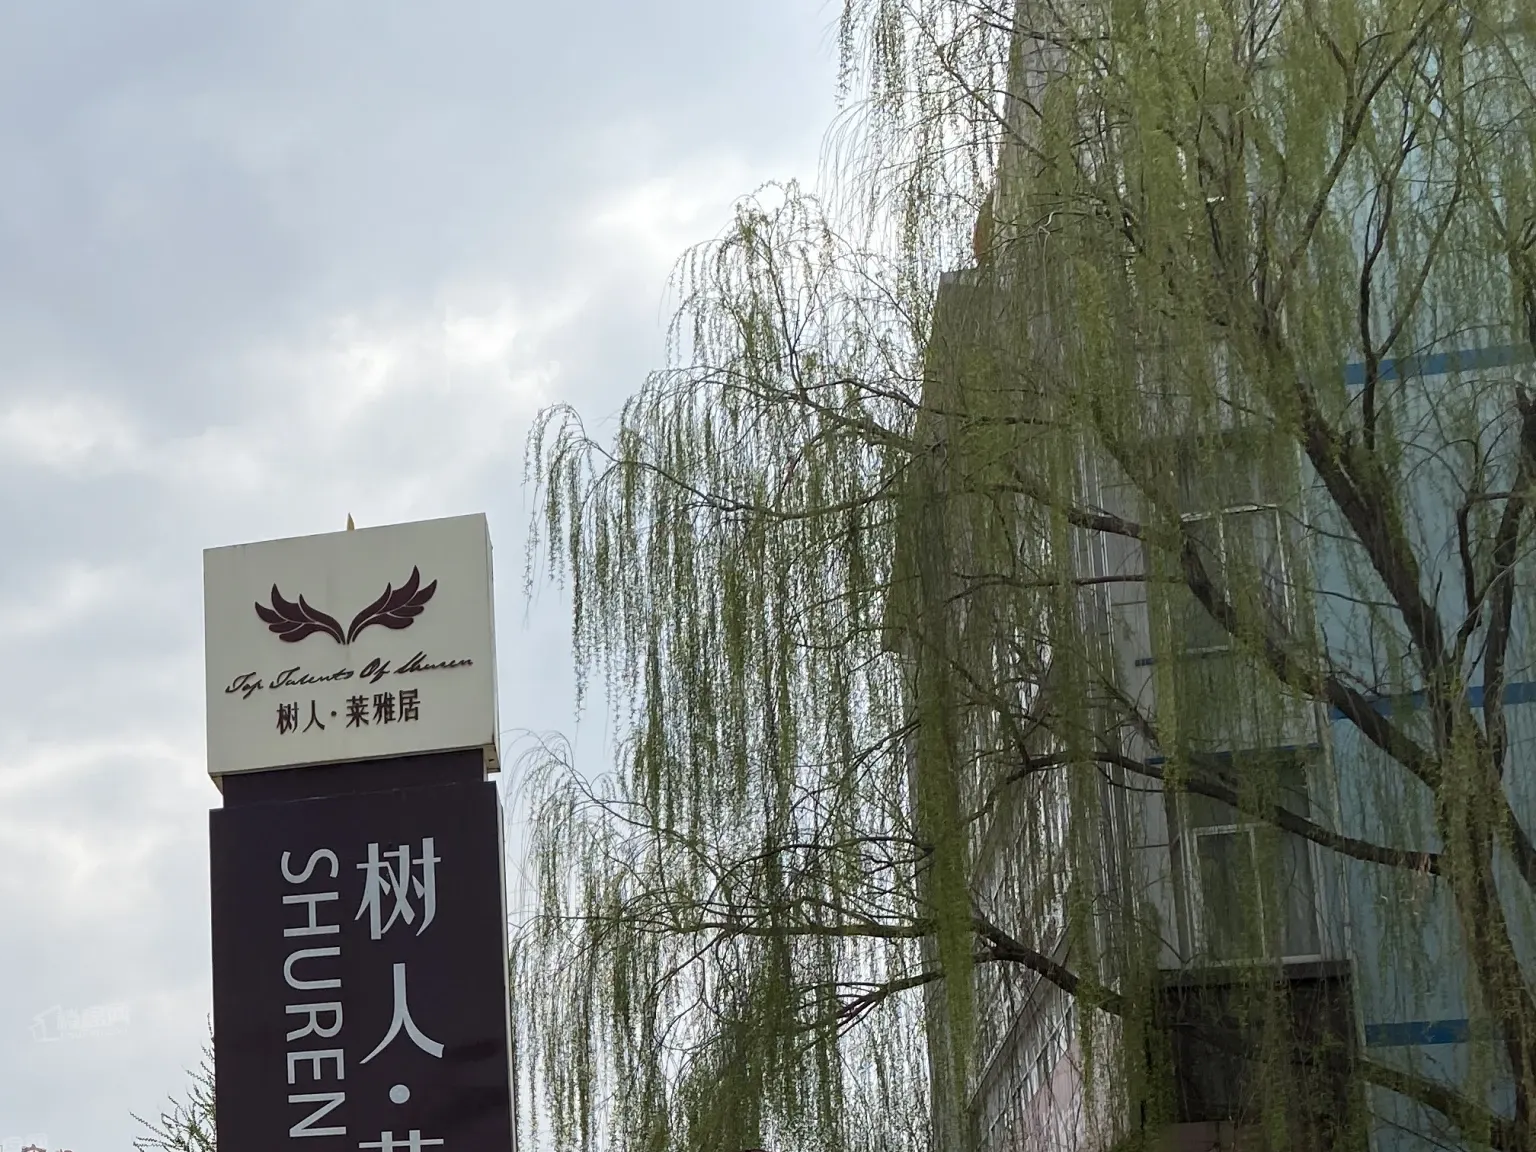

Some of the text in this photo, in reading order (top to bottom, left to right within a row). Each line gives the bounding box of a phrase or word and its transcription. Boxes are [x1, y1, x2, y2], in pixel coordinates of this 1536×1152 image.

[225, 672, 263, 699] Top
[269, 666, 354, 690] Talents
[360, 657, 390, 683] Of
[276, 688, 421, 734] 树人·莱雅居
[280, 848, 347, 1138] SHUREN
